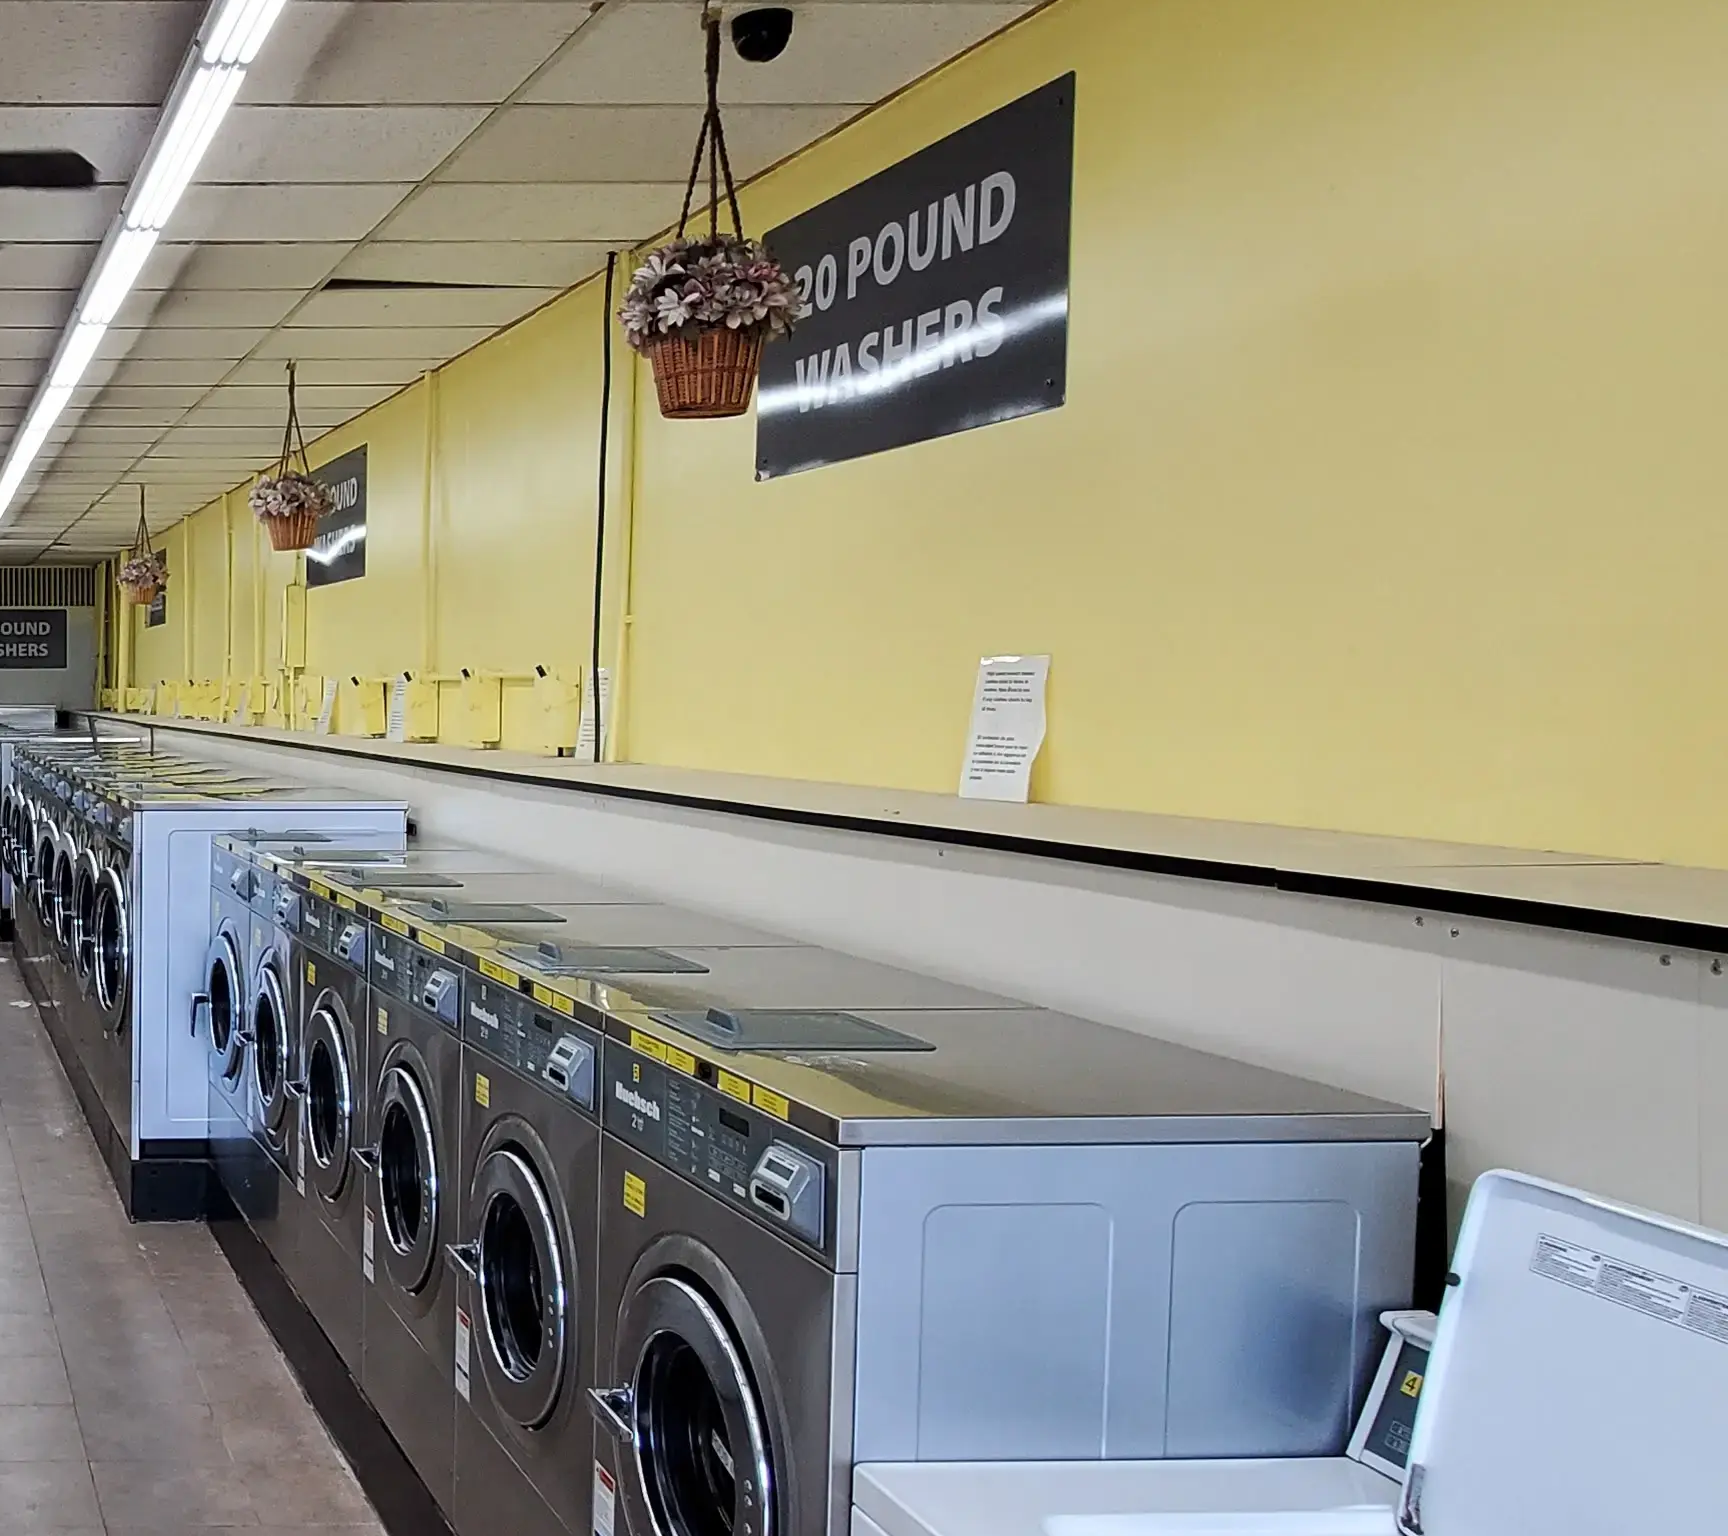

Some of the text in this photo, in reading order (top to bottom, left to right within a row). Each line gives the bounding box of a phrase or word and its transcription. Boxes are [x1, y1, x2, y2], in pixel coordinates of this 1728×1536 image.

[793, 170, 1017, 320] 20 POUND
[794, 286, 1005, 414] WASHERS
[330, 476, 358, 511] OUND
[1405, 1376, 1418, 1392] 4
